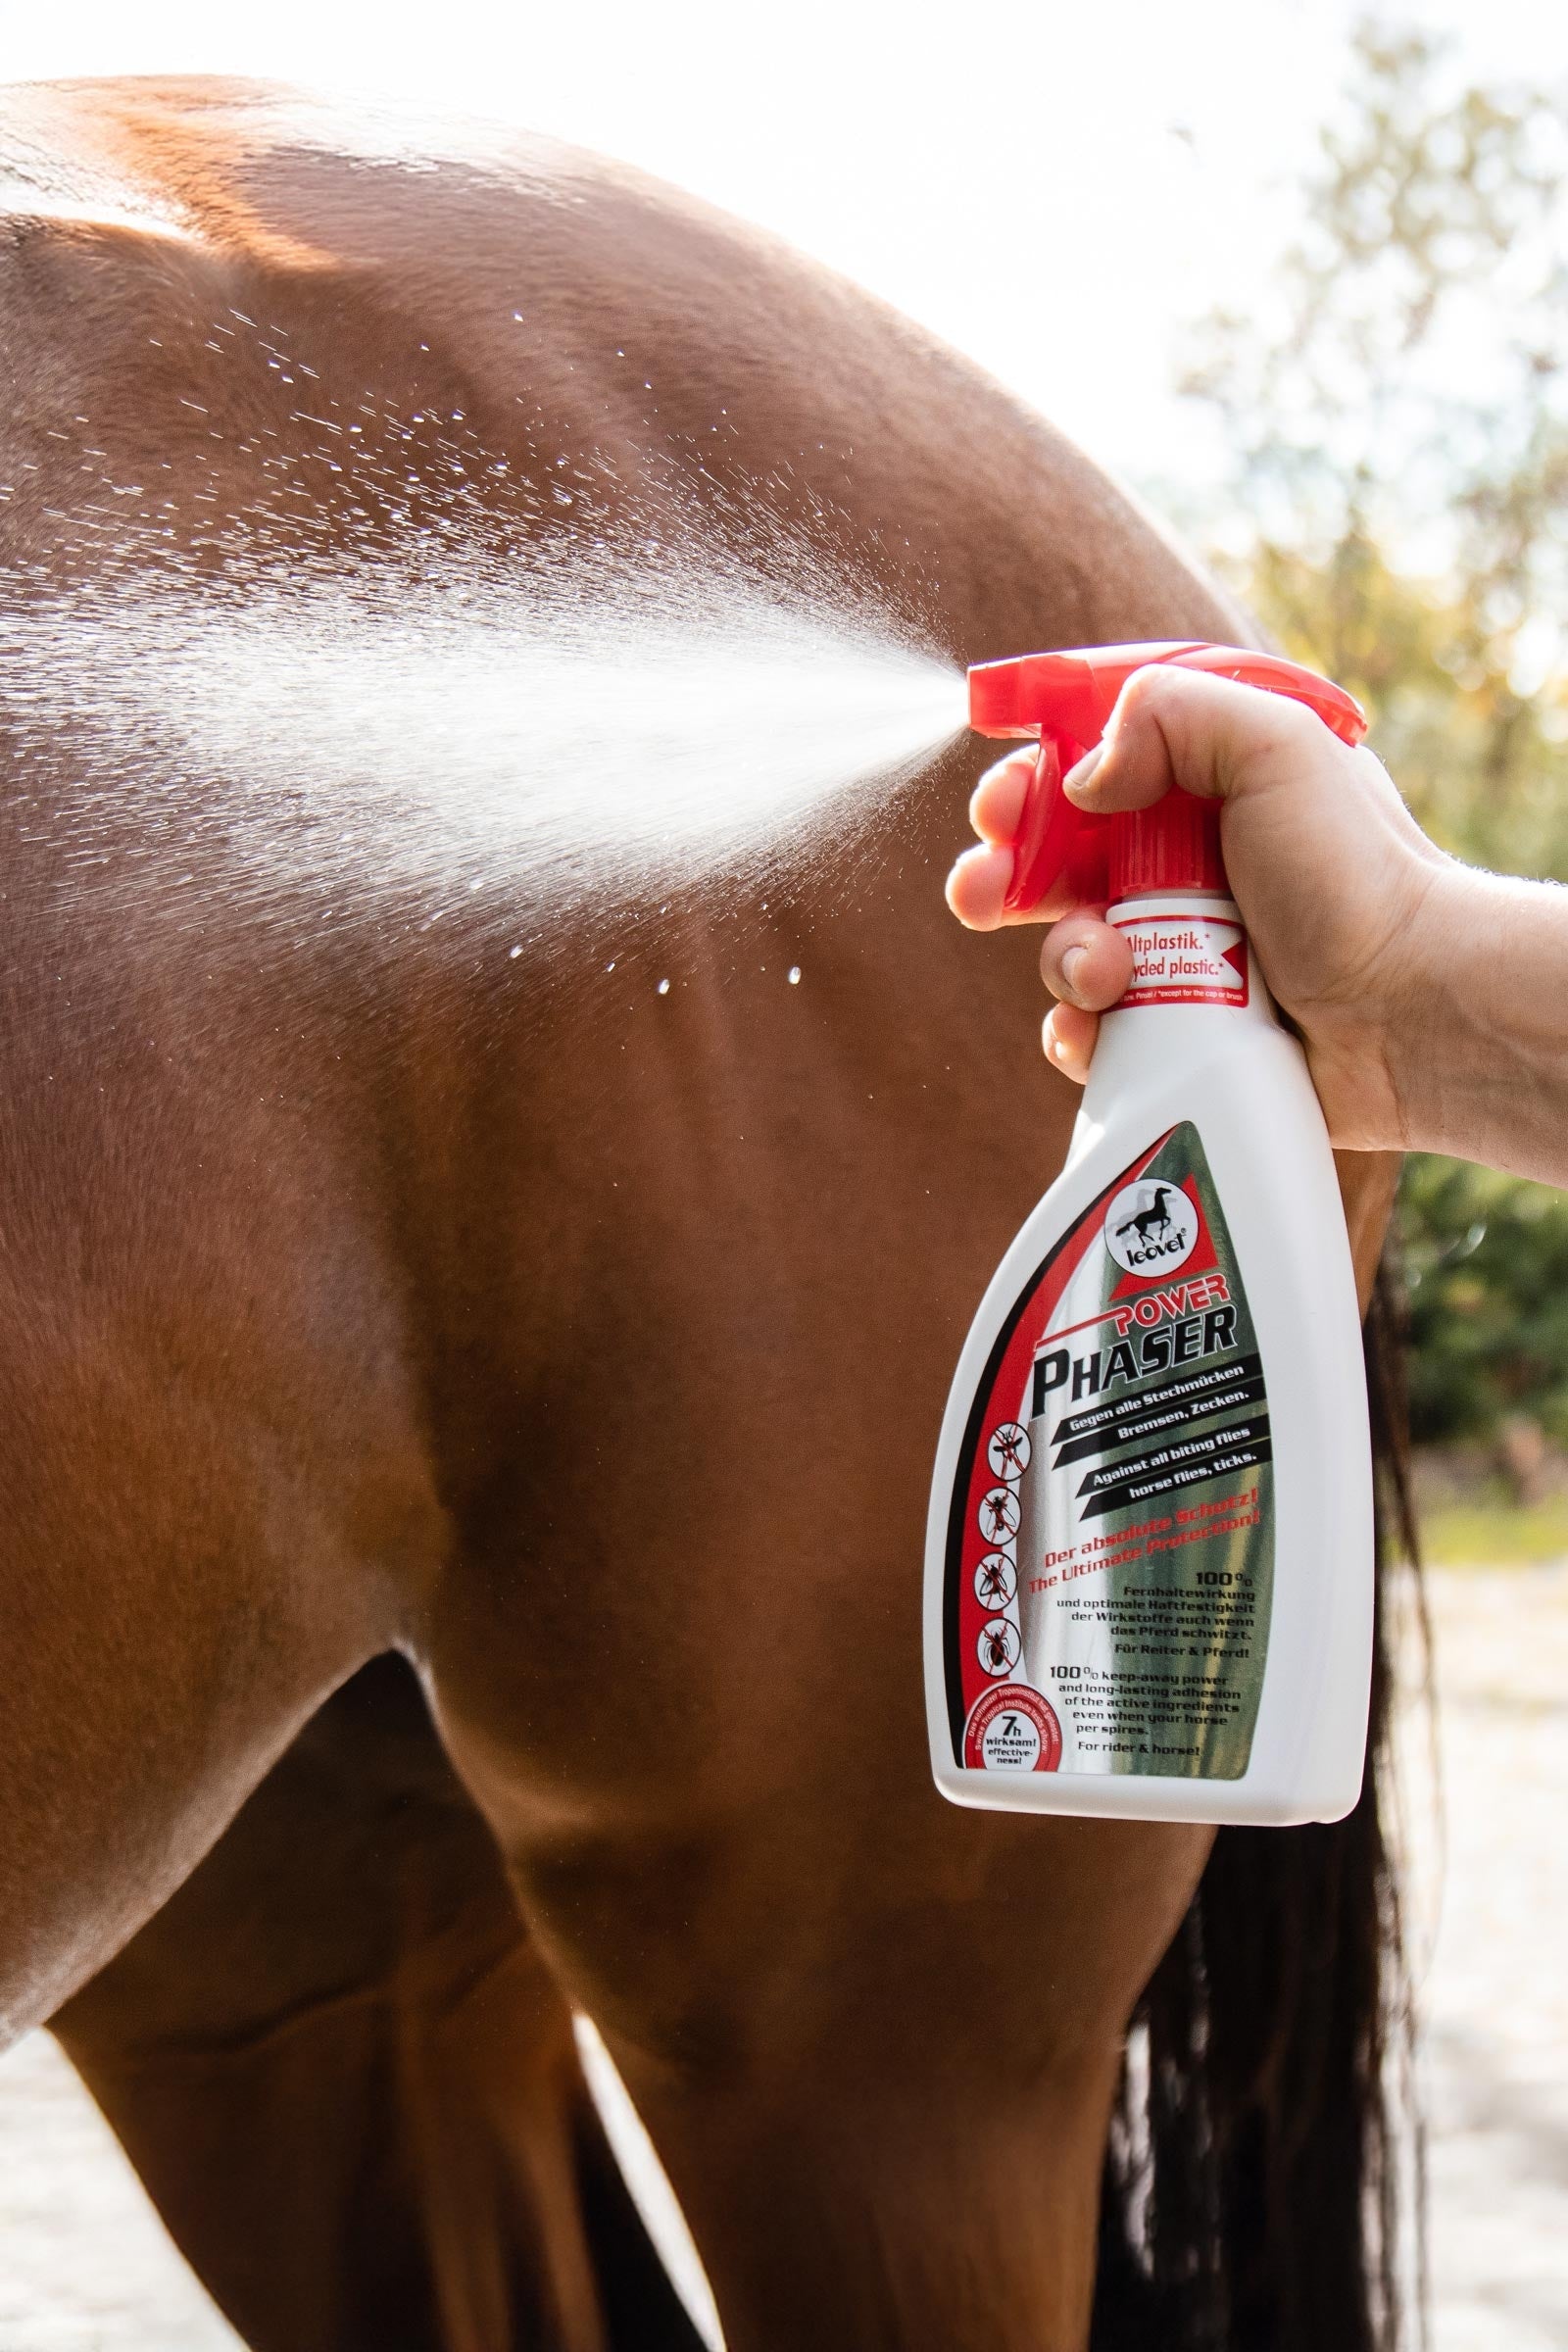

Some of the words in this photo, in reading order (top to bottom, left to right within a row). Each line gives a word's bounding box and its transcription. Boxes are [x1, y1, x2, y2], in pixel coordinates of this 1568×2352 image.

[1227, 992, 1244, 1001] brush
[1111, 1273, 1231, 1337] POWER
[1031, 1303, 1239, 1420] PHASER
[1070, 1409, 1114, 1432] Gegen
[1115, 1400, 1143, 1415] alle
[1143, 1365, 1245, 1406] Stechmücken
[1118, 1409, 1190, 1440] Bremsen,
[1191, 1391, 1250, 1415] Zecken.
[1093, 1460, 1150, 1487] Against
[1151, 1452, 1169, 1467] all
[1171, 1439, 1216, 1459] biting
[1216, 1427, 1251, 1446] flies
[1129, 1480, 1173, 1498] horse
[1174, 1464, 1214, 1483] flies,
[1213, 1452, 1257, 1471] ticks.
[1045, 1548, 1077, 1568] Der
[1081, 1517, 1172, 1554] absolute
[1175, 1487, 1258, 1525] Schutz!
[1029, 1576, 1057, 1594] The
[1061, 1545, 1142, 1582] Ultimate
[1146, 1509, 1260, 1554] Protection!
[1124, 1586, 1255, 1602] Fernhaltewirkung
[1056, 1599, 1081, 1608] und
[1083, 1599, 1146, 1610] optimale
[1149, 1600, 1255, 1614] Haftfestigkeit
[1071, 1611, 1093, 1621] der
[1097, 1612, 1173, 1623] Wirkstoffe
[1176, 1615, 1211, 1626] auch
[1214, 1618, 1255, 1628] wenn
[1111, 1626, 1136, 1636] das
[1139, 1626, 1179, 1638] Pferd
[1182, 1628, 1252, 1641] schwitzt.
[1114, 1643, 1139, 1654] Für
[1141, 1644, 1187, 1656] Reiter
[1189, 1646, 1200, 1656] &
[1202, 1646, 1250, 1658] Pferd!
[1102, 1671, 1180, 1686] keep-away
[1182, 1676, 1229, 1687] power
[1058, 1684, 1083, 1693] and
[1085, 1684, 1169, 1698] long-lasting
[1172, 1688, 1242, 1700] adhesion
[1064, 1696, 1081, 1706] of
[1081, 1697, 1103, 1707] the
[1106, 1698, 1151, 1709] active
[1152, 1700, 1241, 1713] ingredients
[975, 1726, 986, 1750] Swiss
[981, 1700, 1005, 1725] Tropical
[1072, 1711, 1104, 1720] even
[1107, 1711, 1145, 1722] when
[1148, 1714, 1182, 1725] your
[1185, 1714, 1228, 1726] horse
[1076, 1724, 1100, 1735] per
[1101, 1724, 1150, 1736] spires.
[986, 1737, 1037, 1747] wirksam!
[1077, 1740, 1100, 1751] For
[1102, 1741, 1136, 1753] rider
[1139, 1743, 1150, 1754] &
[1152, 1743, 1200, 1756] horse!
[988, 1747, 1033, 1756] effective-
